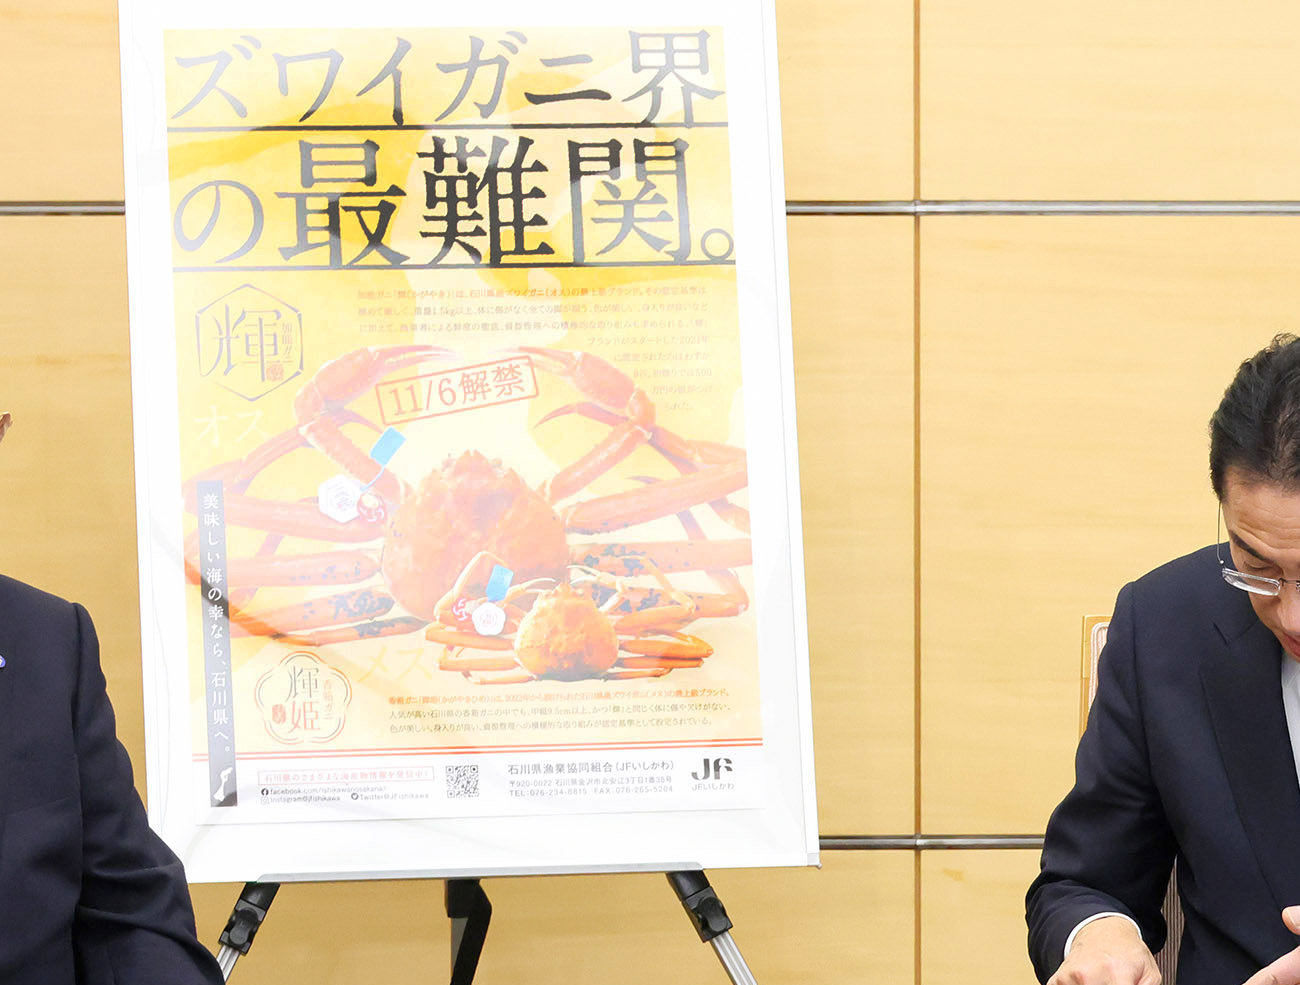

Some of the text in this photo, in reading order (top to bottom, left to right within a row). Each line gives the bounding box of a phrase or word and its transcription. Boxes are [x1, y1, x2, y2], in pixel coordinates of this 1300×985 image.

[170, 29, 726, 127] ズワイガニ界
[173, 135, 735, 268] の最難関。
[389, 363, 525, 416] 11/6解禁
[203, 493, 231, 752] 美味しい海の幸なら、石川県へ。
[691, 757, 733, 781] JF
